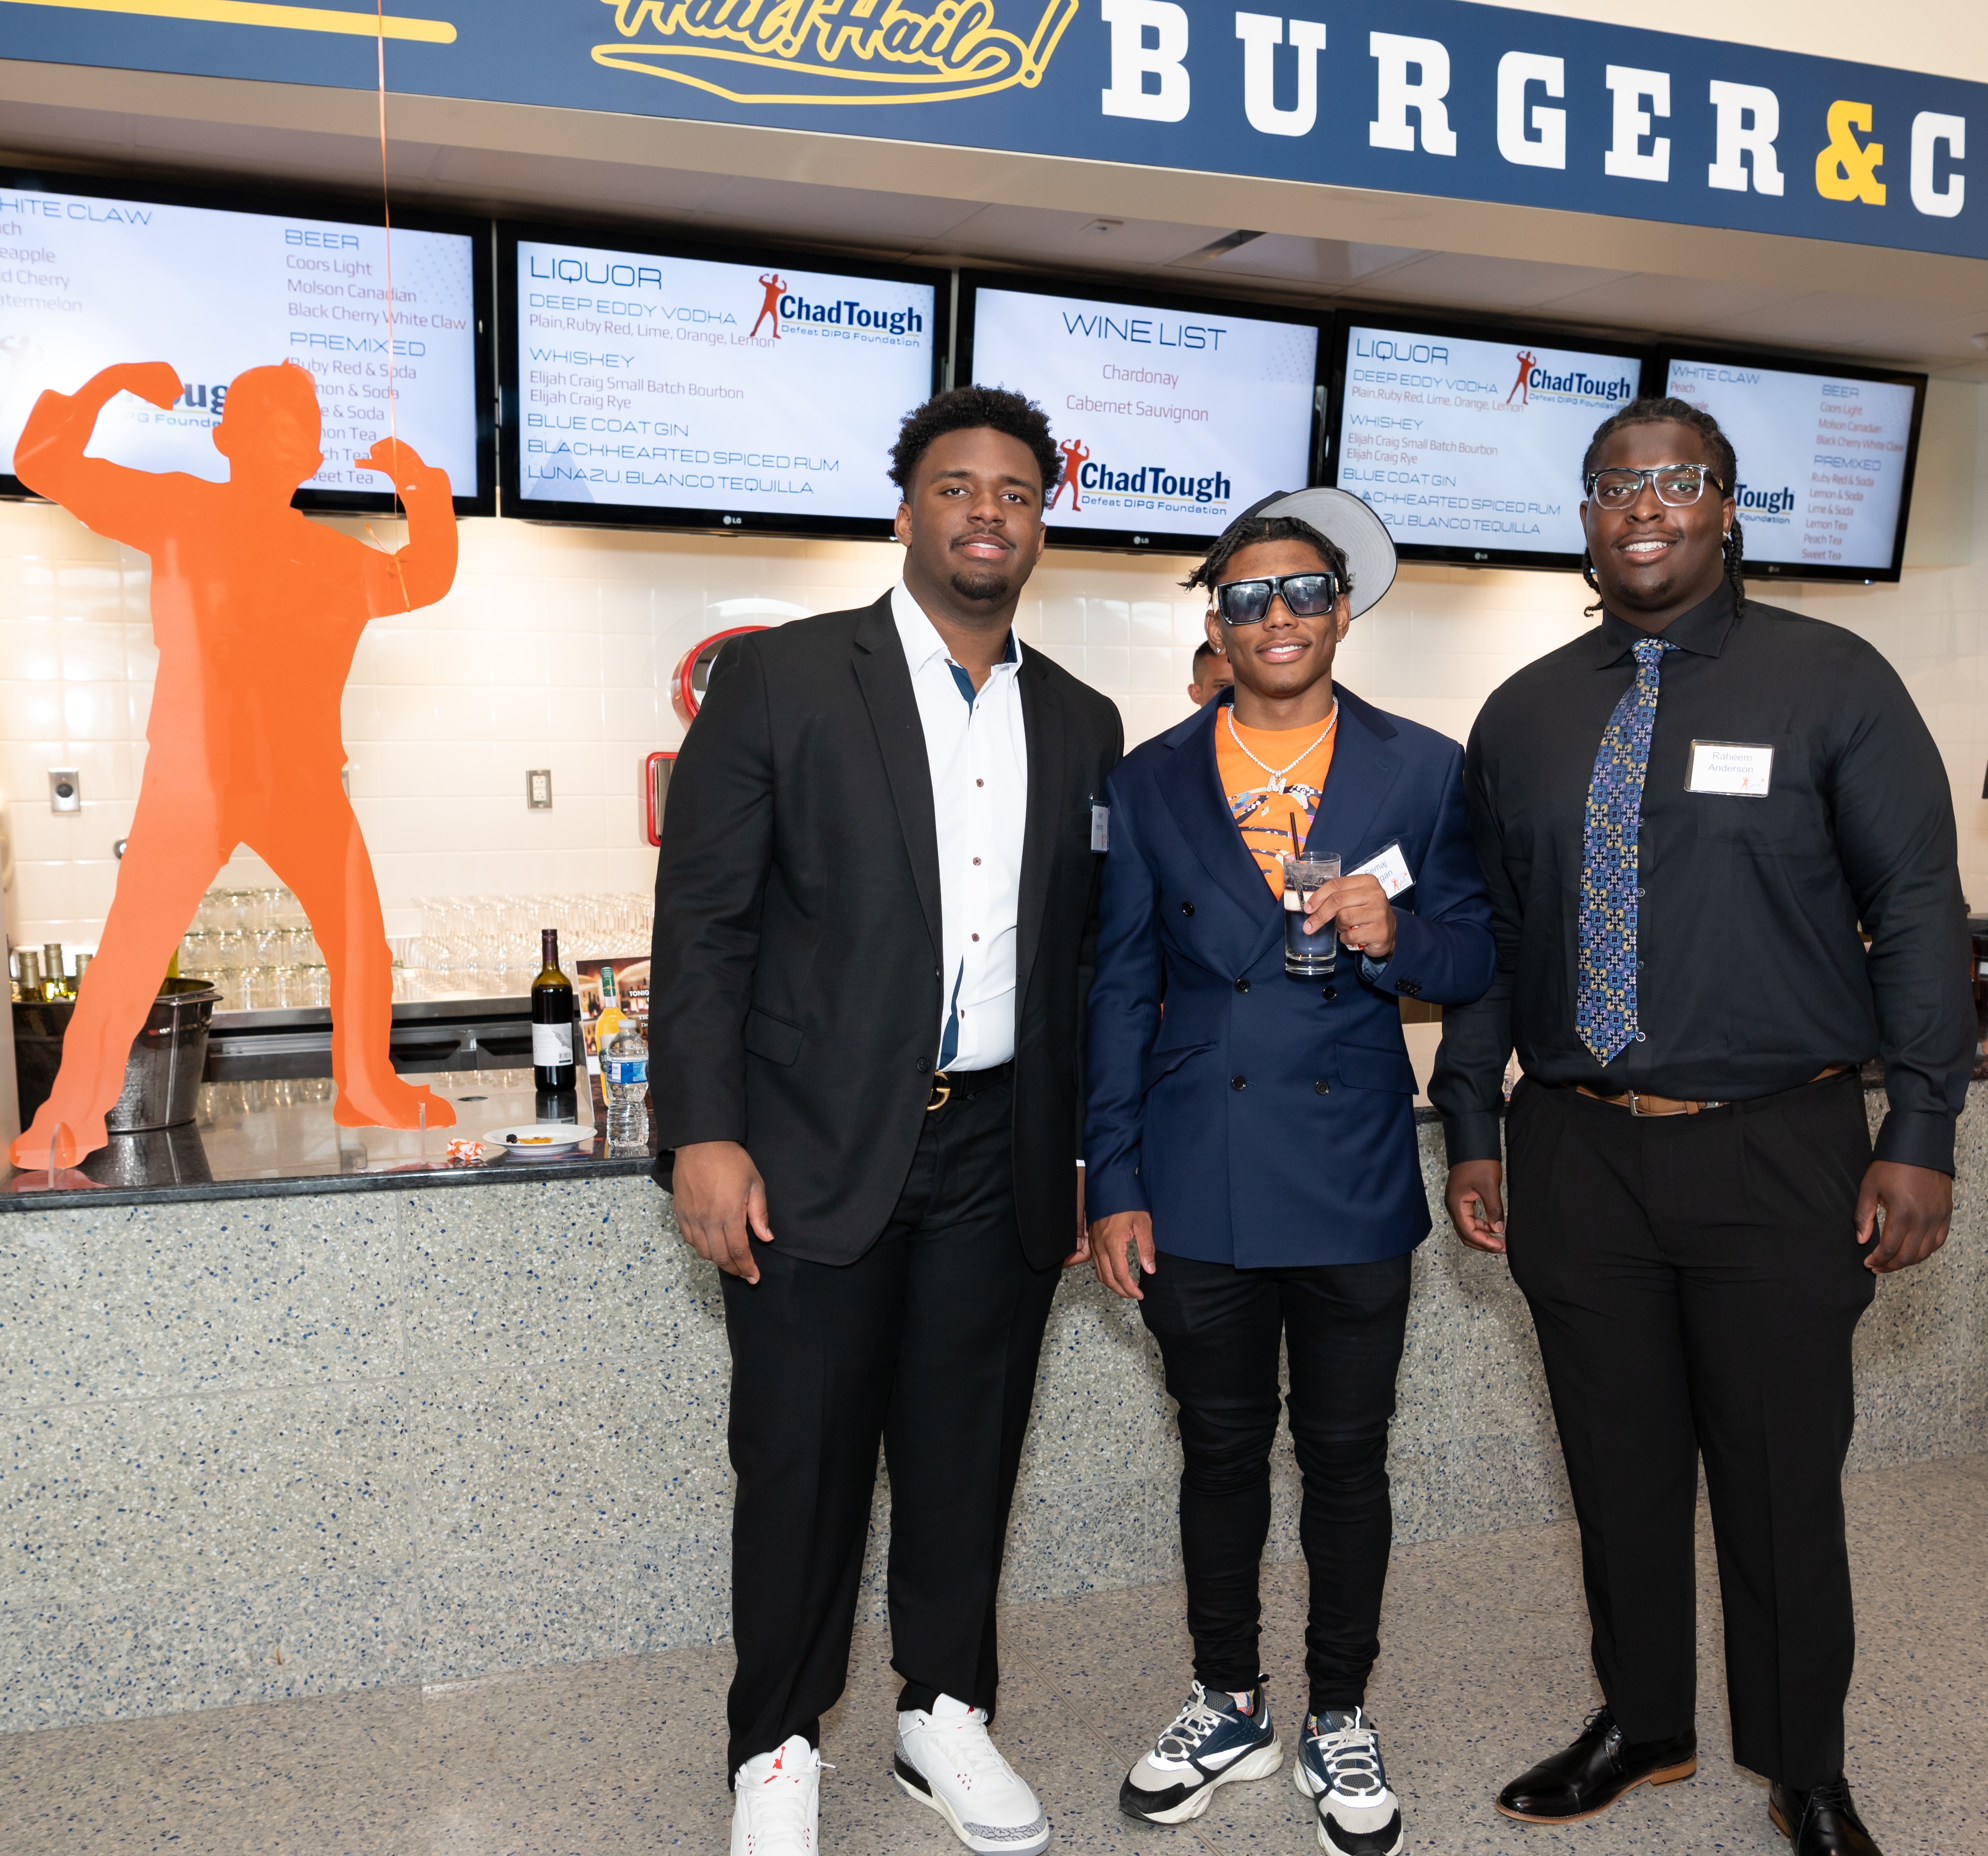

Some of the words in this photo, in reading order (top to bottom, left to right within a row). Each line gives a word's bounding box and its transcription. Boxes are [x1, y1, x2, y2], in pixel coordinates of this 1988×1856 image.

[1101, 0, 1784, 196] BURGER
[1815, 100, 1886, 205] &
[67, 203, 152, 226] CLAW
[285, 229, 359, 250] BEER
[287, 255, 330, 272] Coors
[334, 259, 372, 277] Light
[531, 256, 662, 290] LIQUOR
[17, 269, 69, 290] Cherry
[288, 279, 344, 296] Molson
[348, 284, 417, 302] Canadian
[289, 302, 328, 319] Black
[332, 305, 379, 326] Cherry
[383, 310, 428, 327] White
[432, 314, 467, 330] Claw
[530, 293, 592, 311] DEEP
[597, 300, 657, 317] EDDY
[780, 295, 922, 335] ChadTough
[605, 321, 634, 337] Red,
[638, 324, 673, 341] Lime,
[677, 327, 727, 347] Orange,
[731, 332, 775, 348] Lemon
[781, 325, 819, 336] Defeat
[822, 329, 850, 340] DIPG
[854, 333, 920, 348] Foundation
[1063, 312, 1152, 344] WINE
[1159, 322, 1227, 351] LIST
[290, 332, 425, 357] PREMIXED
[1356, 338, 1449, 366] LIQUOR
[332, 360, 362, 376] Red
[365, 361, 376, 377] &
[380, 363, 417, 379] Soda
[1103, 364, 1179, 390] Chardonay
[1353, 369, 1398, 383] DEEP
[1400, 374, 1443, 389] EDDY
[1672, 365, 1716, 381] WHITE
[1718, 370, 1761, 384] CLAW
[348, 383, 359, 397] &
[362, 384, 399, 400] Soda
[530, 371, 566, 388] Elijah
[570, 374, 603, 391] Craig
[607, 377, 644, 392] Small
[647, 380, 685, 395] Batch
[689, 383, 744, 399] Bourbon
[1529, 368, 1630, 401] ChadTough
[1670, 380, 1695, 393] Peach
[1822, 384, 1860, 399] BEER
[530, 389, 566, 406] Elijah
[570, 392, 603, 410] Craig
[607, 395, 631, 411] Rye
[1403, 391, 1425, 404] Red,
[1492, 400, 1524, 413] Lemon
[1528, 392, 1555, 402] Defeat
[333, 404, 344, 418] &
[347, 405, 384, 421] Soda
[1067, 395, 1132, 416] Cabernet
[1136, 401, 1209, 424] Sauvignon
[350, 427, 377, 441] Tea
[528, 413, 587, 430] BLUE
[591, 418, 650, 434] COAT
[655, 423, 689, 437] GIN
[1348, 432, 1373, 447] Elijah
[1375, 435, 1399, 450] Craig
[1402, 437, 1428, 450] Small
[1430, 440, 1457, 453] Batch
[1459, 442, 1498, 456] Bourbon
[714, 452, 790, 469] SPICED
[794, 457, 839, 472] RUM
[1347, 448, 1372, 462] Elijah
[1374, 450, 1398, 465] Craig
[1400, 452, 1418, 466] Rye
[1814, 454, 1882, 471] PREMIXED
[346, 470, 374, 485] Tea
[626, 471, 714, 488] BLANCO
[718, 476, 814, 494] TEQUILLA
[1081, 462, 1231, 503] ChadTough
[1343, 467, 1385, 482] BLUE
[1387, 471, 1430, 486] COAT
[1432, 474, 1456, 487] GIN
[1082, 495, 1121, 507] Defeat
[1124, 499, 1154, 510] DIPG
[1158, 501, 1227, 516] Foundation
[1471, 498, 1526, 513] SPICED
[1528, 502, 1560, 516] RUM
[1408, 515, 1471, 530] BLANCO
[1473, 519, 1541, 535] TEQUILLA
[1739, 513, 1791, 524] Foundation
[1712, 751, 1752, 762] Raheem
[1708, 764, 1754, 773] Anderson
